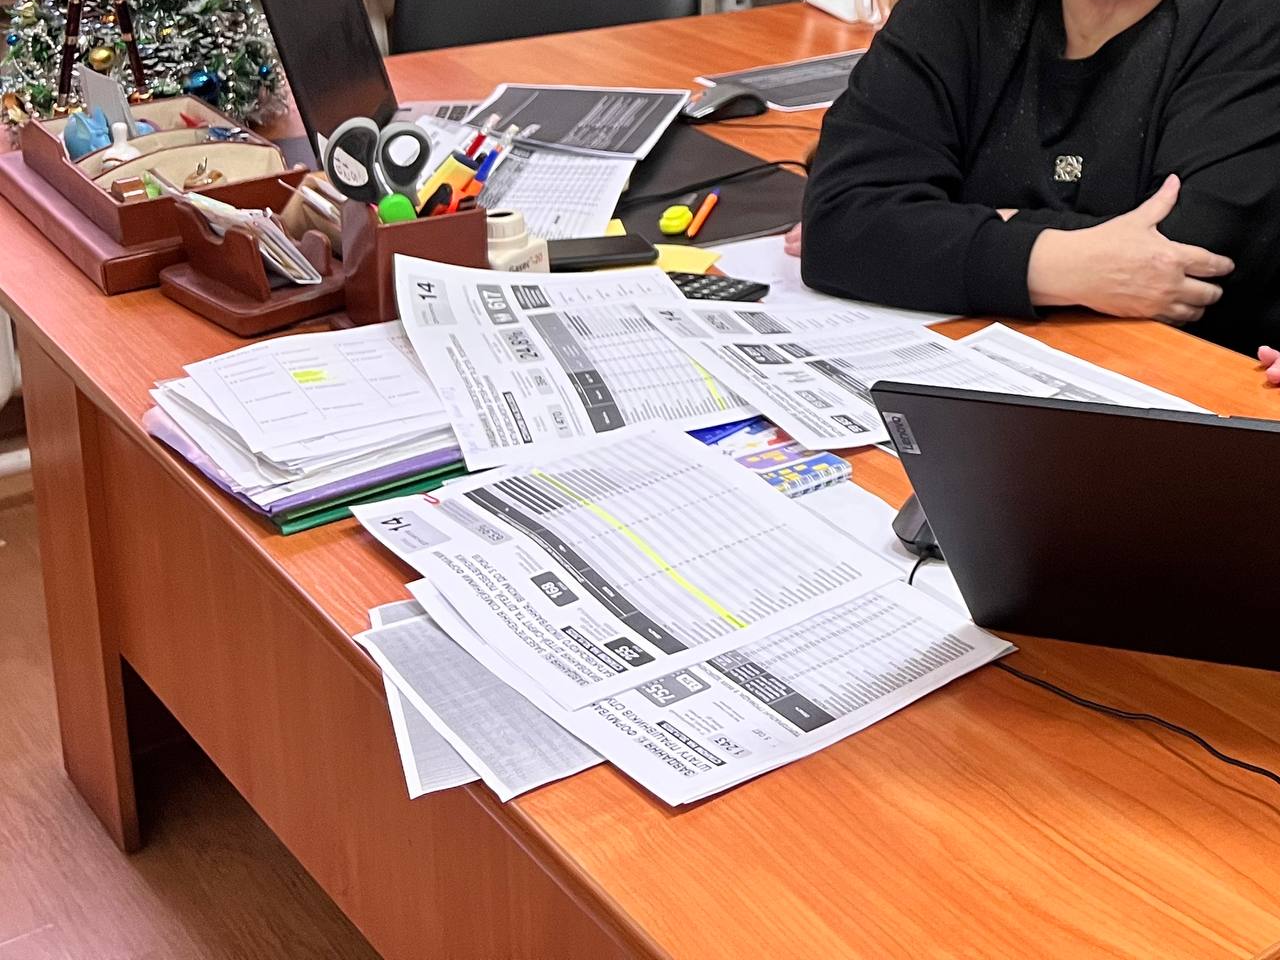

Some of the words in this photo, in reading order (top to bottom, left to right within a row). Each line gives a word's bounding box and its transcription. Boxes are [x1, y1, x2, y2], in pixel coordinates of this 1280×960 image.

[415, 280, 437, 300] 14
[892, 416, 914, 450] Lenovo
[379, 514, 412, 532] 14
[620, 709, 682, 751] ПРАЦІВНИКІВ
[643, 742, 696, 776] ЗАВДАННЯ
[676, 750, 713, 772] ШТАТУ
